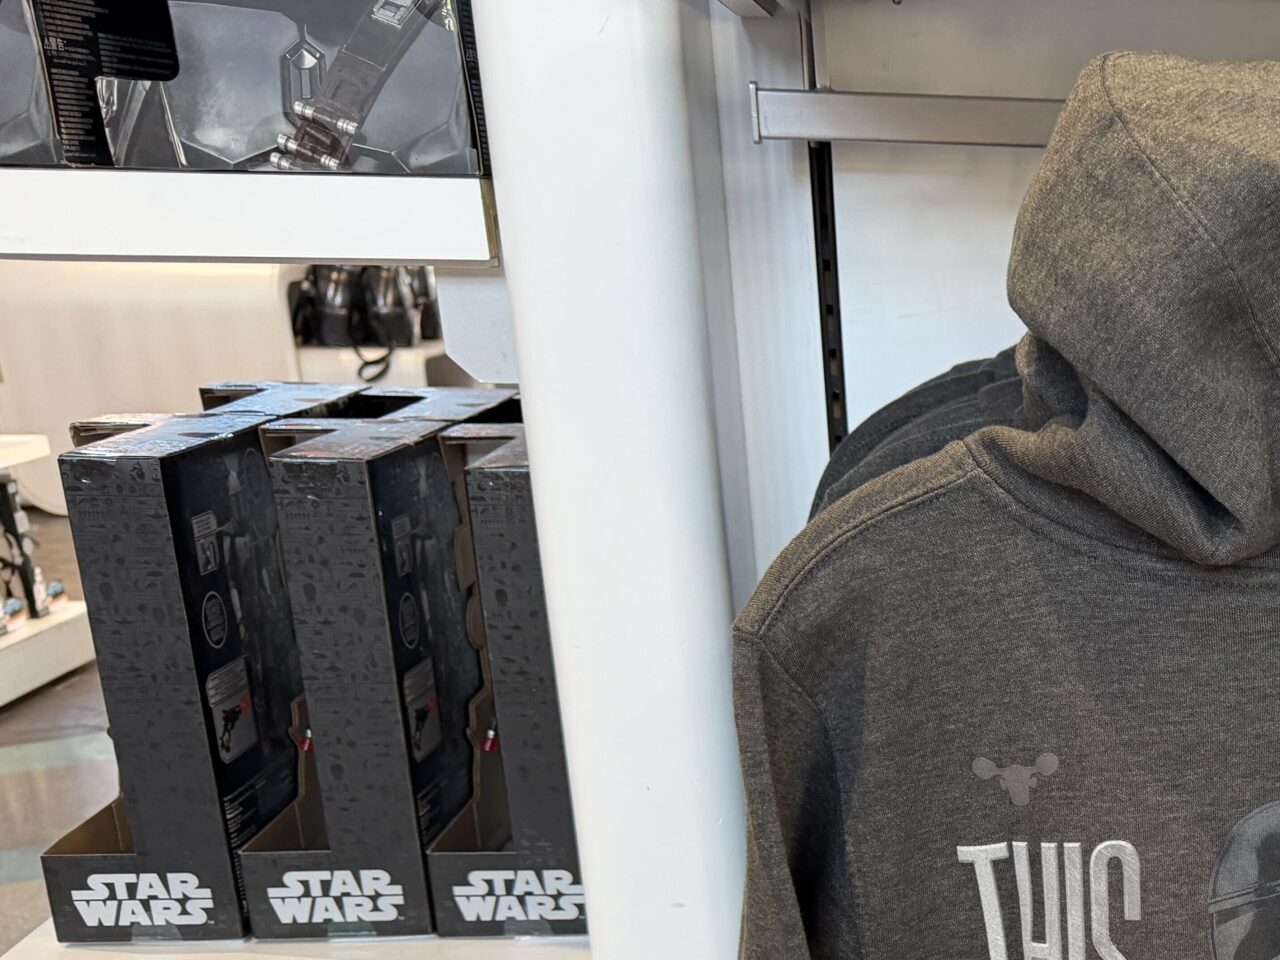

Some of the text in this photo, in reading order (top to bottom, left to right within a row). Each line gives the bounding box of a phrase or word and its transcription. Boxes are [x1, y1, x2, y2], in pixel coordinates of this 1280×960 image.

[71, 872, 213, 900] STAR
[266, 869, 404, 898] STAR
[452, 869, 585, 896] STAR
[72, 898, 214, 927] WARS
[267, 896, 405, 924] WARS
[454, 895, 586, 922] WARS
